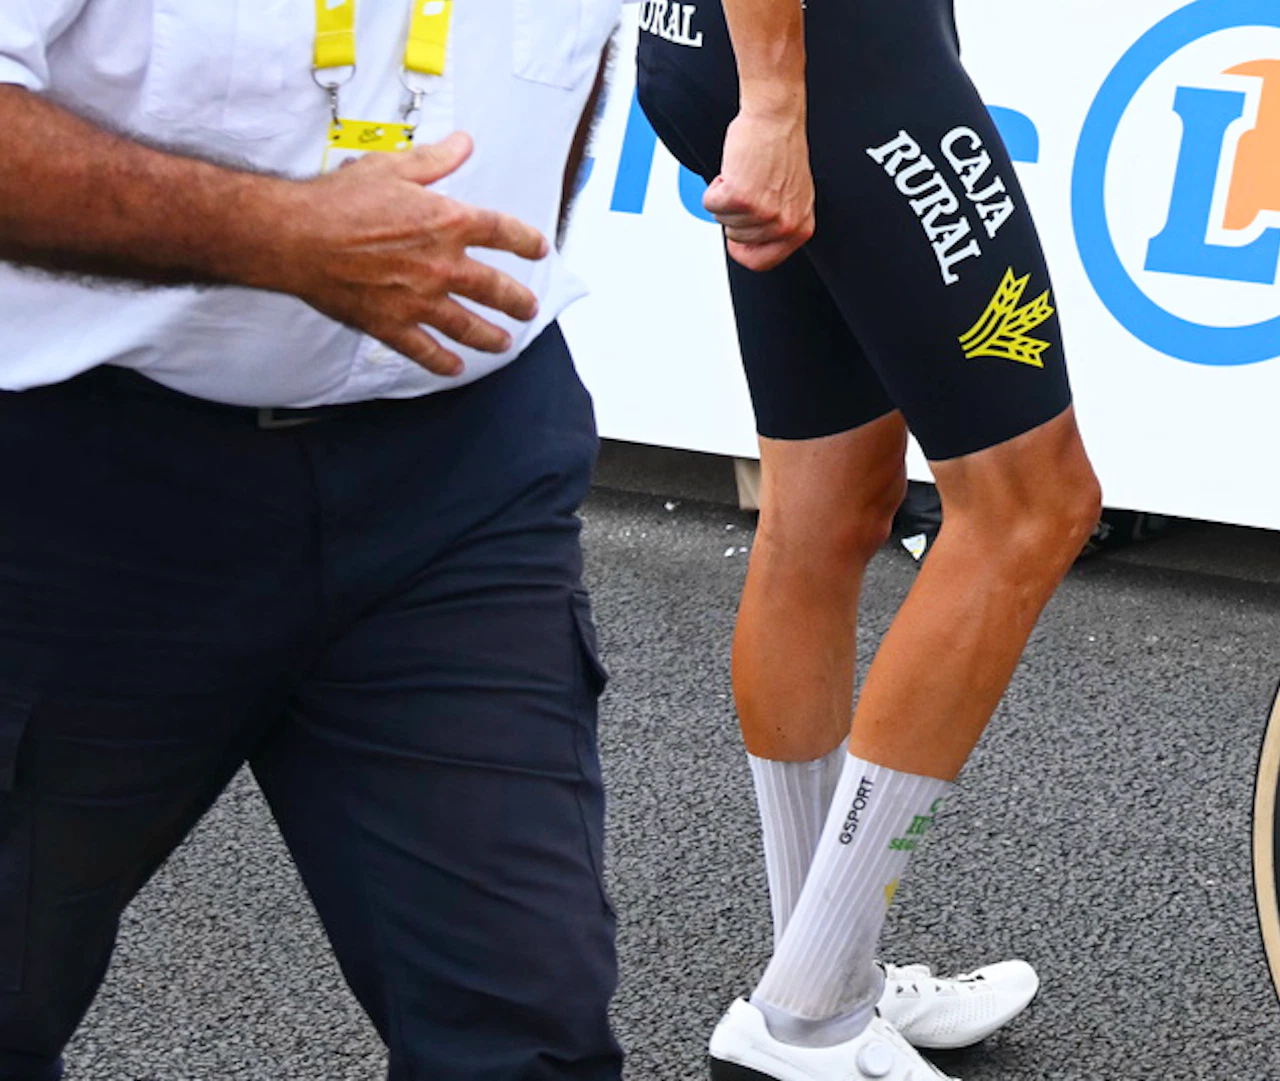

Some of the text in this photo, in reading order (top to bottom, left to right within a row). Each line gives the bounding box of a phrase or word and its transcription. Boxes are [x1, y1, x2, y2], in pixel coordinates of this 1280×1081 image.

[866, 130, 983, 286] RURAL
[940, 126, 1016, 239] CAJA
[838, 775, 875, 846] GSPORT
